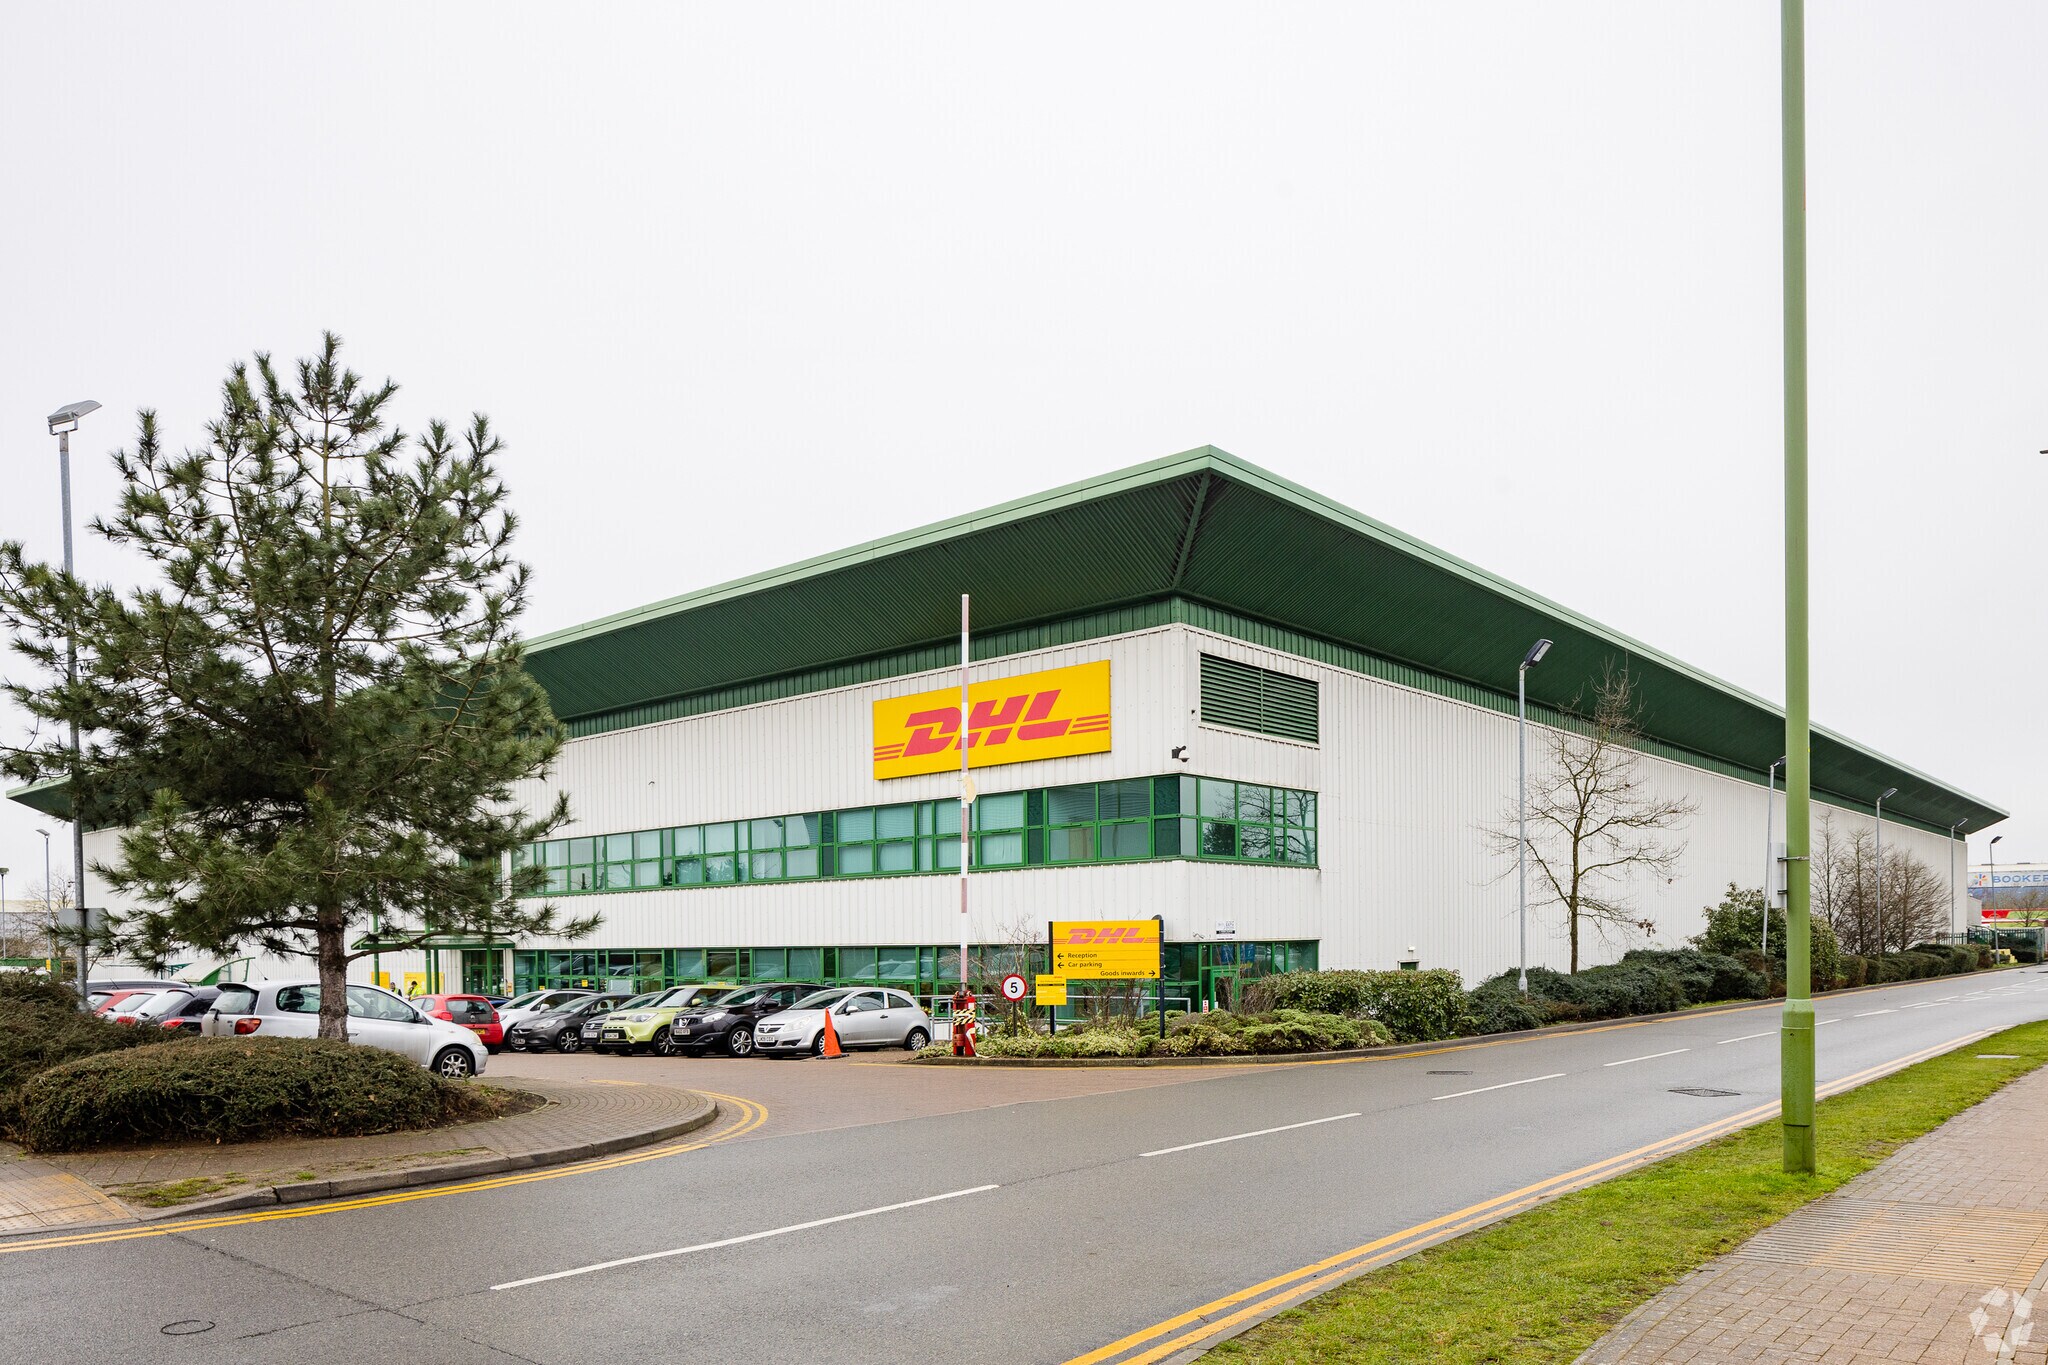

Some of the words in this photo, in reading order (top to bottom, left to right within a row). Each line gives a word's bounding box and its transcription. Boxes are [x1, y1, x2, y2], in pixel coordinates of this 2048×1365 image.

[902, 689, 1072, 757] DHL
[1993, 874, 2048, 883] BOOKER
[1067, 927, 1145, 945] DHL
[1067, 952, 1098, 960] Reception
[1079, 961, 1103, 969] parking
[1010, 982, 1018, 993] 5
